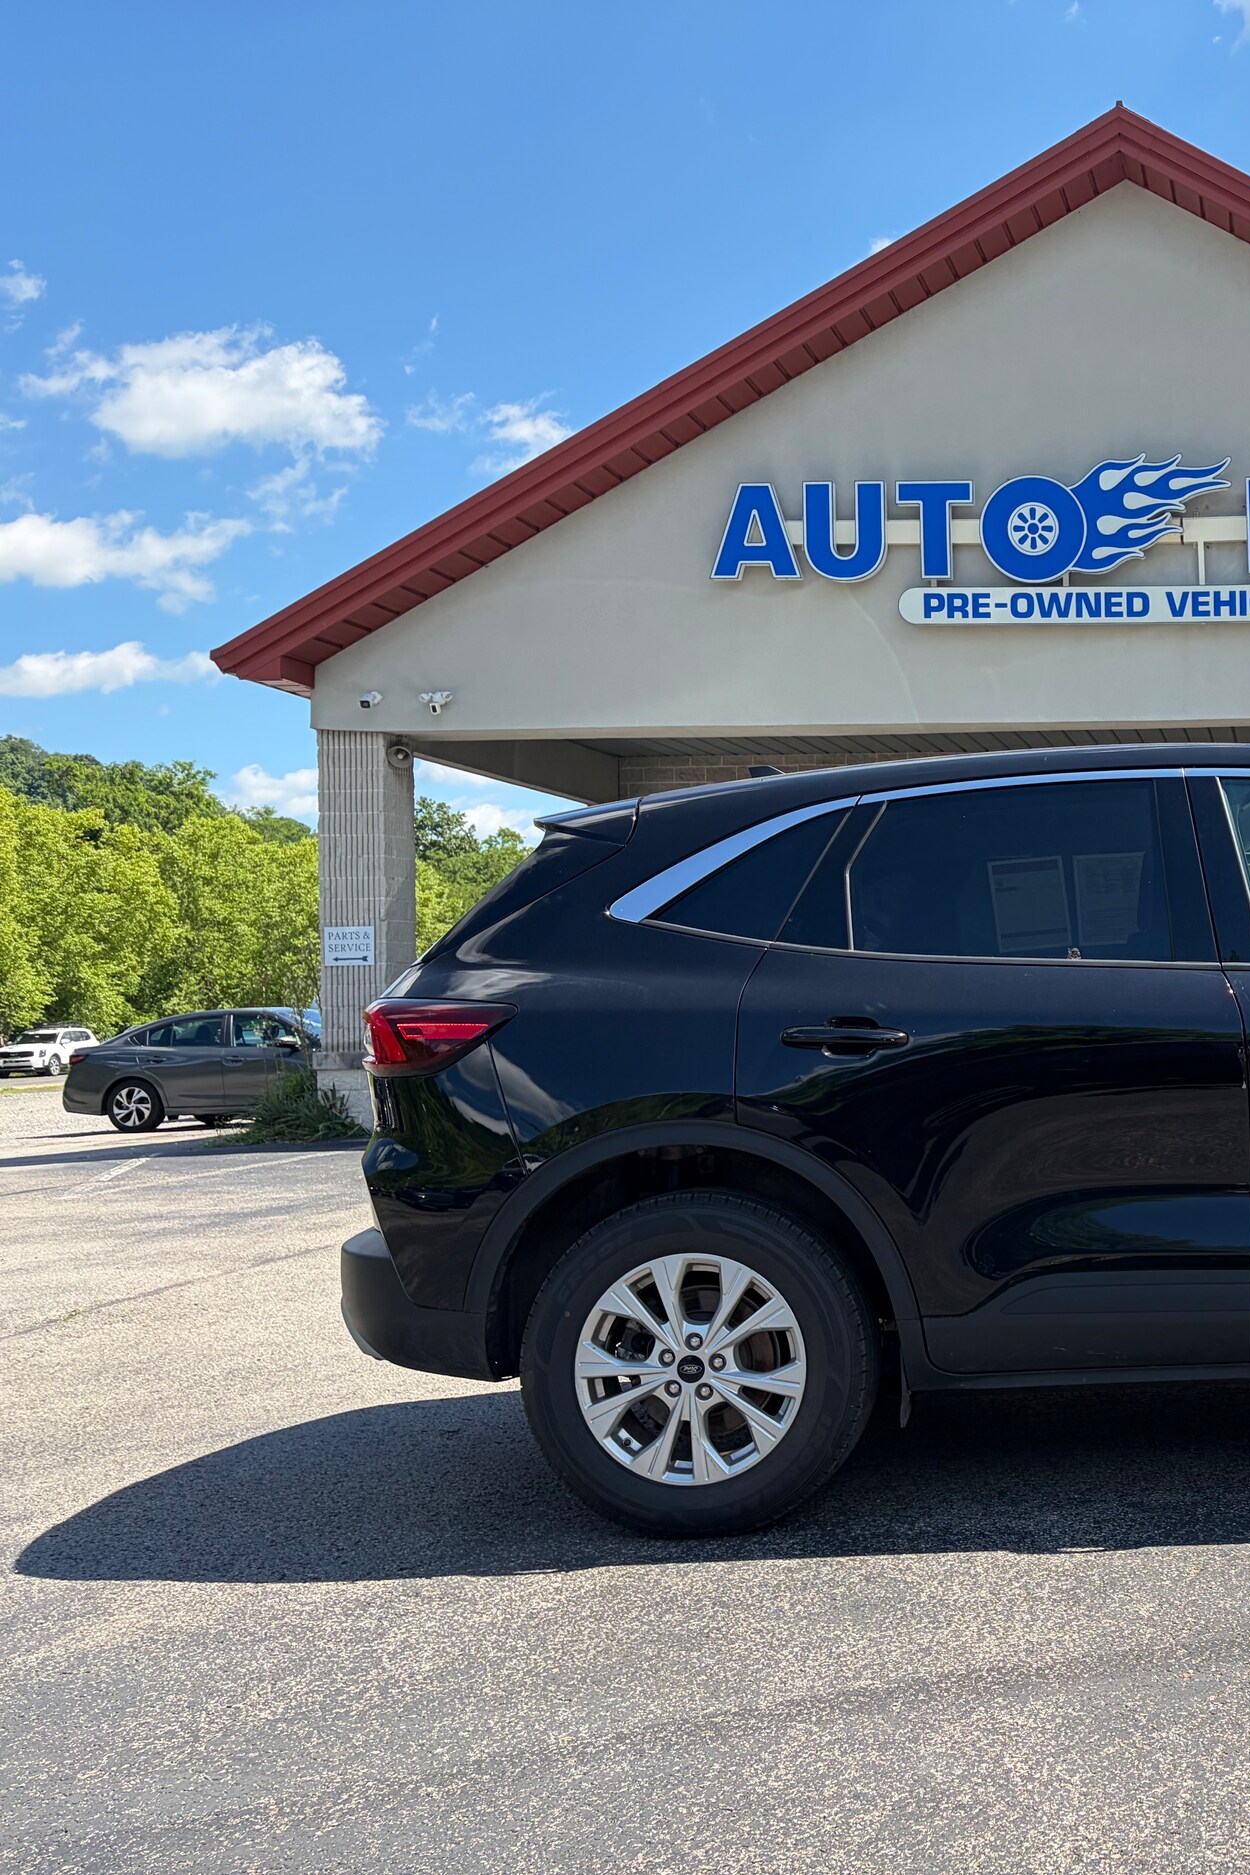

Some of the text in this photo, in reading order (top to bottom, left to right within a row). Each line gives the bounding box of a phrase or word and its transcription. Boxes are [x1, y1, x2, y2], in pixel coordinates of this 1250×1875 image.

[711, 476, 1087, 583] AUTO
[923, 590, 1151, 620] PRE-OWNED
[328, 930, 370, 941] PARTS &
[328, 943, 372, 953] SERVICE
